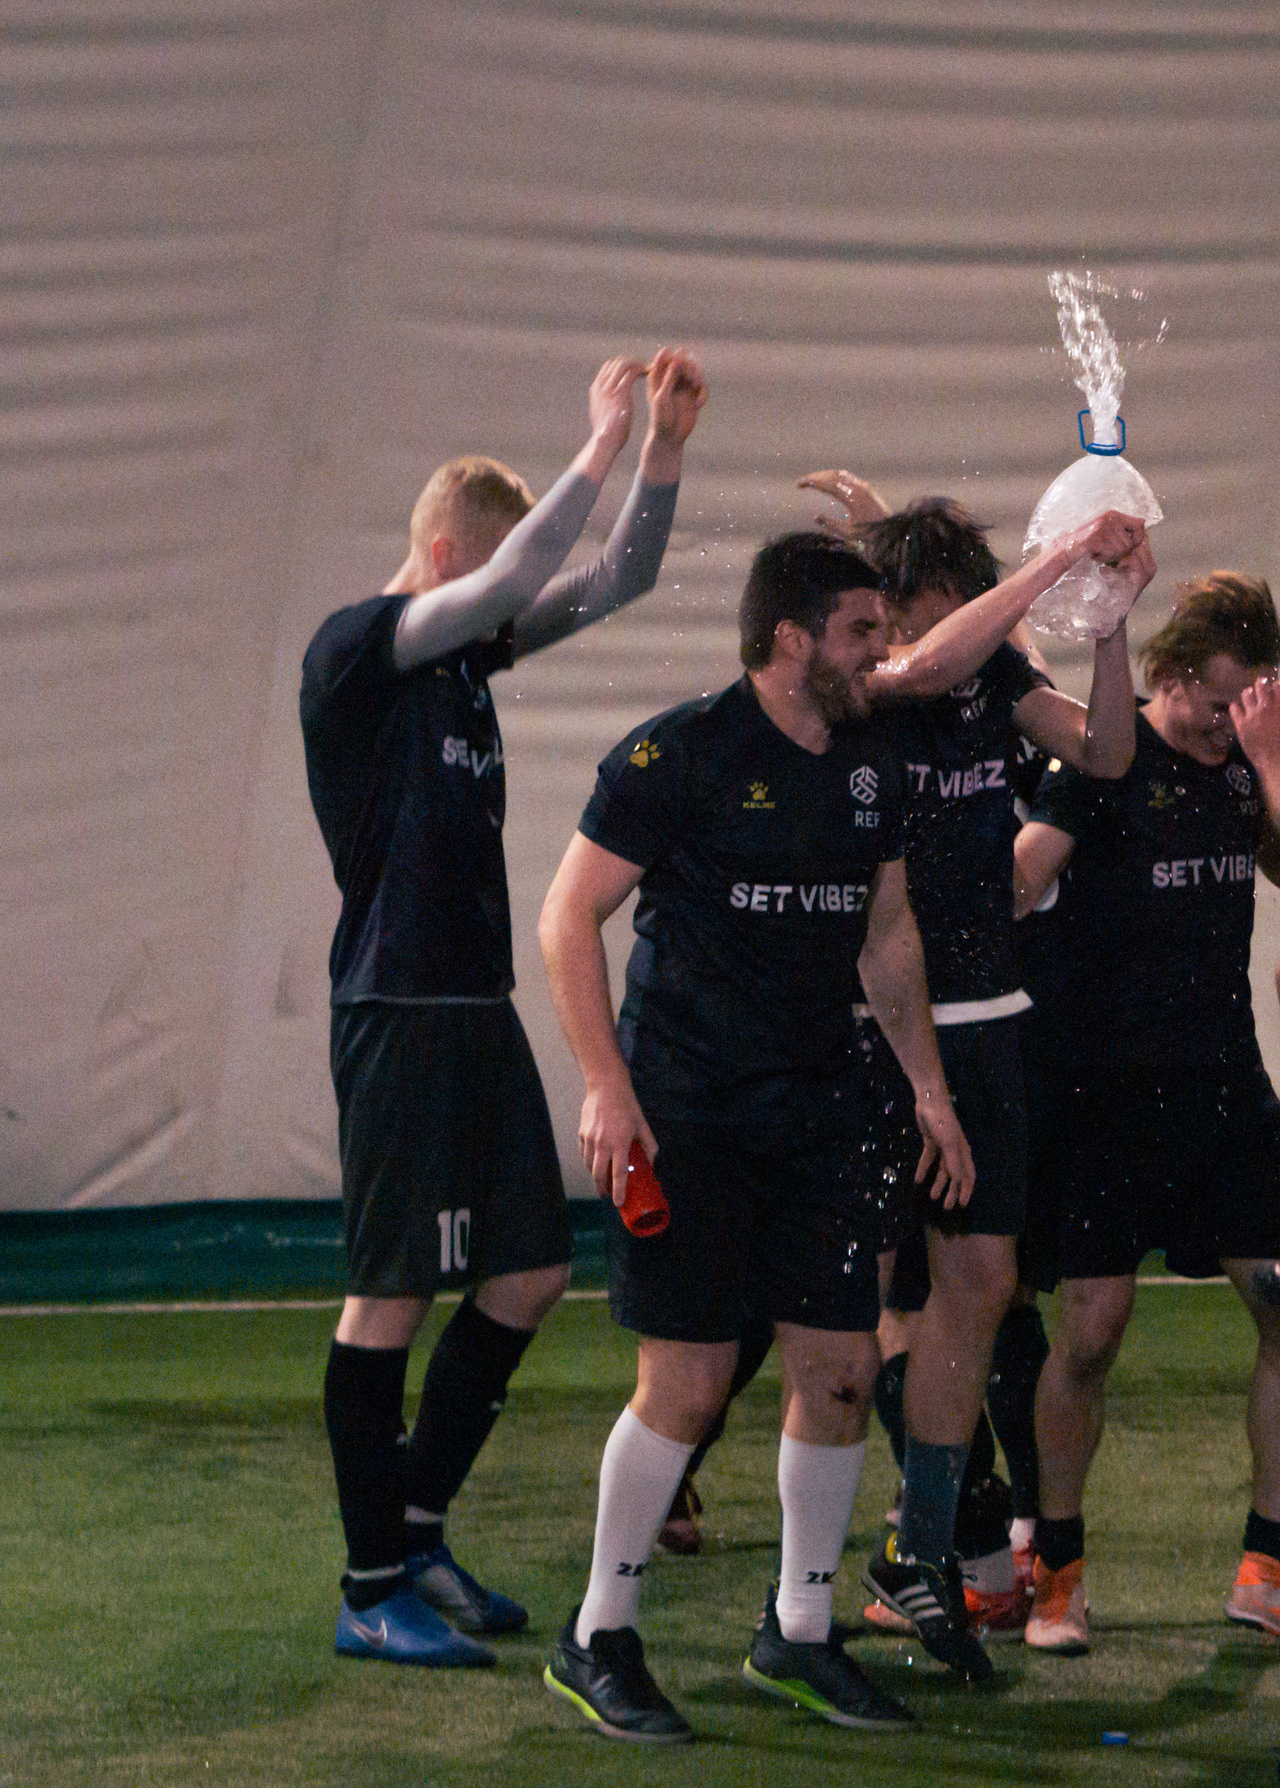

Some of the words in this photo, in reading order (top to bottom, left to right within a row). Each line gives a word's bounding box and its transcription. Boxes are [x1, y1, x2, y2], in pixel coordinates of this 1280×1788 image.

[937, 758, 1006, 798] VIBEZ
[855, 810, 880, 828] REF
[1152, 858, 1204, 888] SET
[730, 882, 793, 913] SET
[438, 1207, 470, 1274] 10
